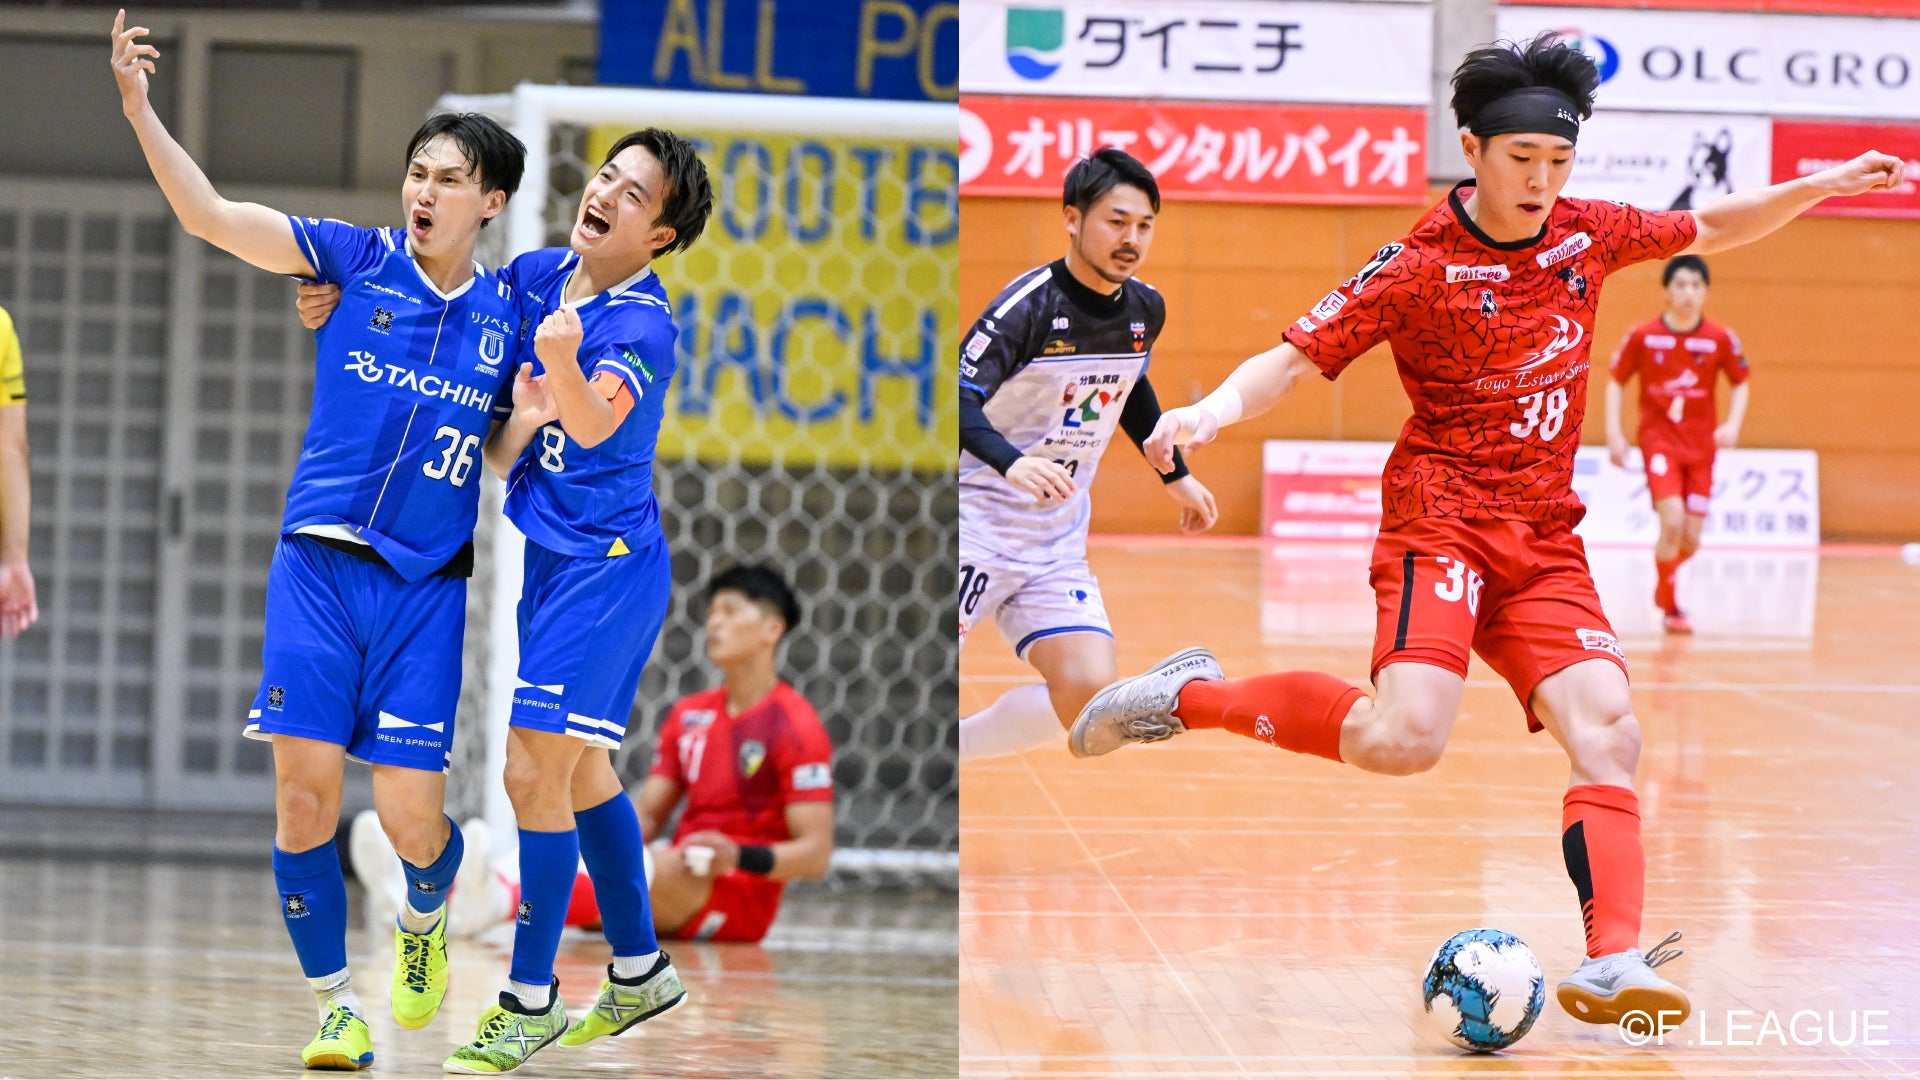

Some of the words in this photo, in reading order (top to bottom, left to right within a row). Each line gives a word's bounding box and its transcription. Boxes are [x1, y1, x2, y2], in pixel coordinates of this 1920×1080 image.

[1079, 16, 1303, 73] ダイニチ
[1642, 46, 1760, 83] OLC
[1785, 51, 1910, 89] GRO
[471, 311, 513, 335] リノベる。
[385, 363, 493, 413] TACHIHI
[1510, 387, 1569, 442] 38
[422, 425, 481, 488] 36
[522, 699, 560, 710] SPRINGS
[376, 733, 403, 745] GREEN
[405, 738, 442, 749] SPRINGS
